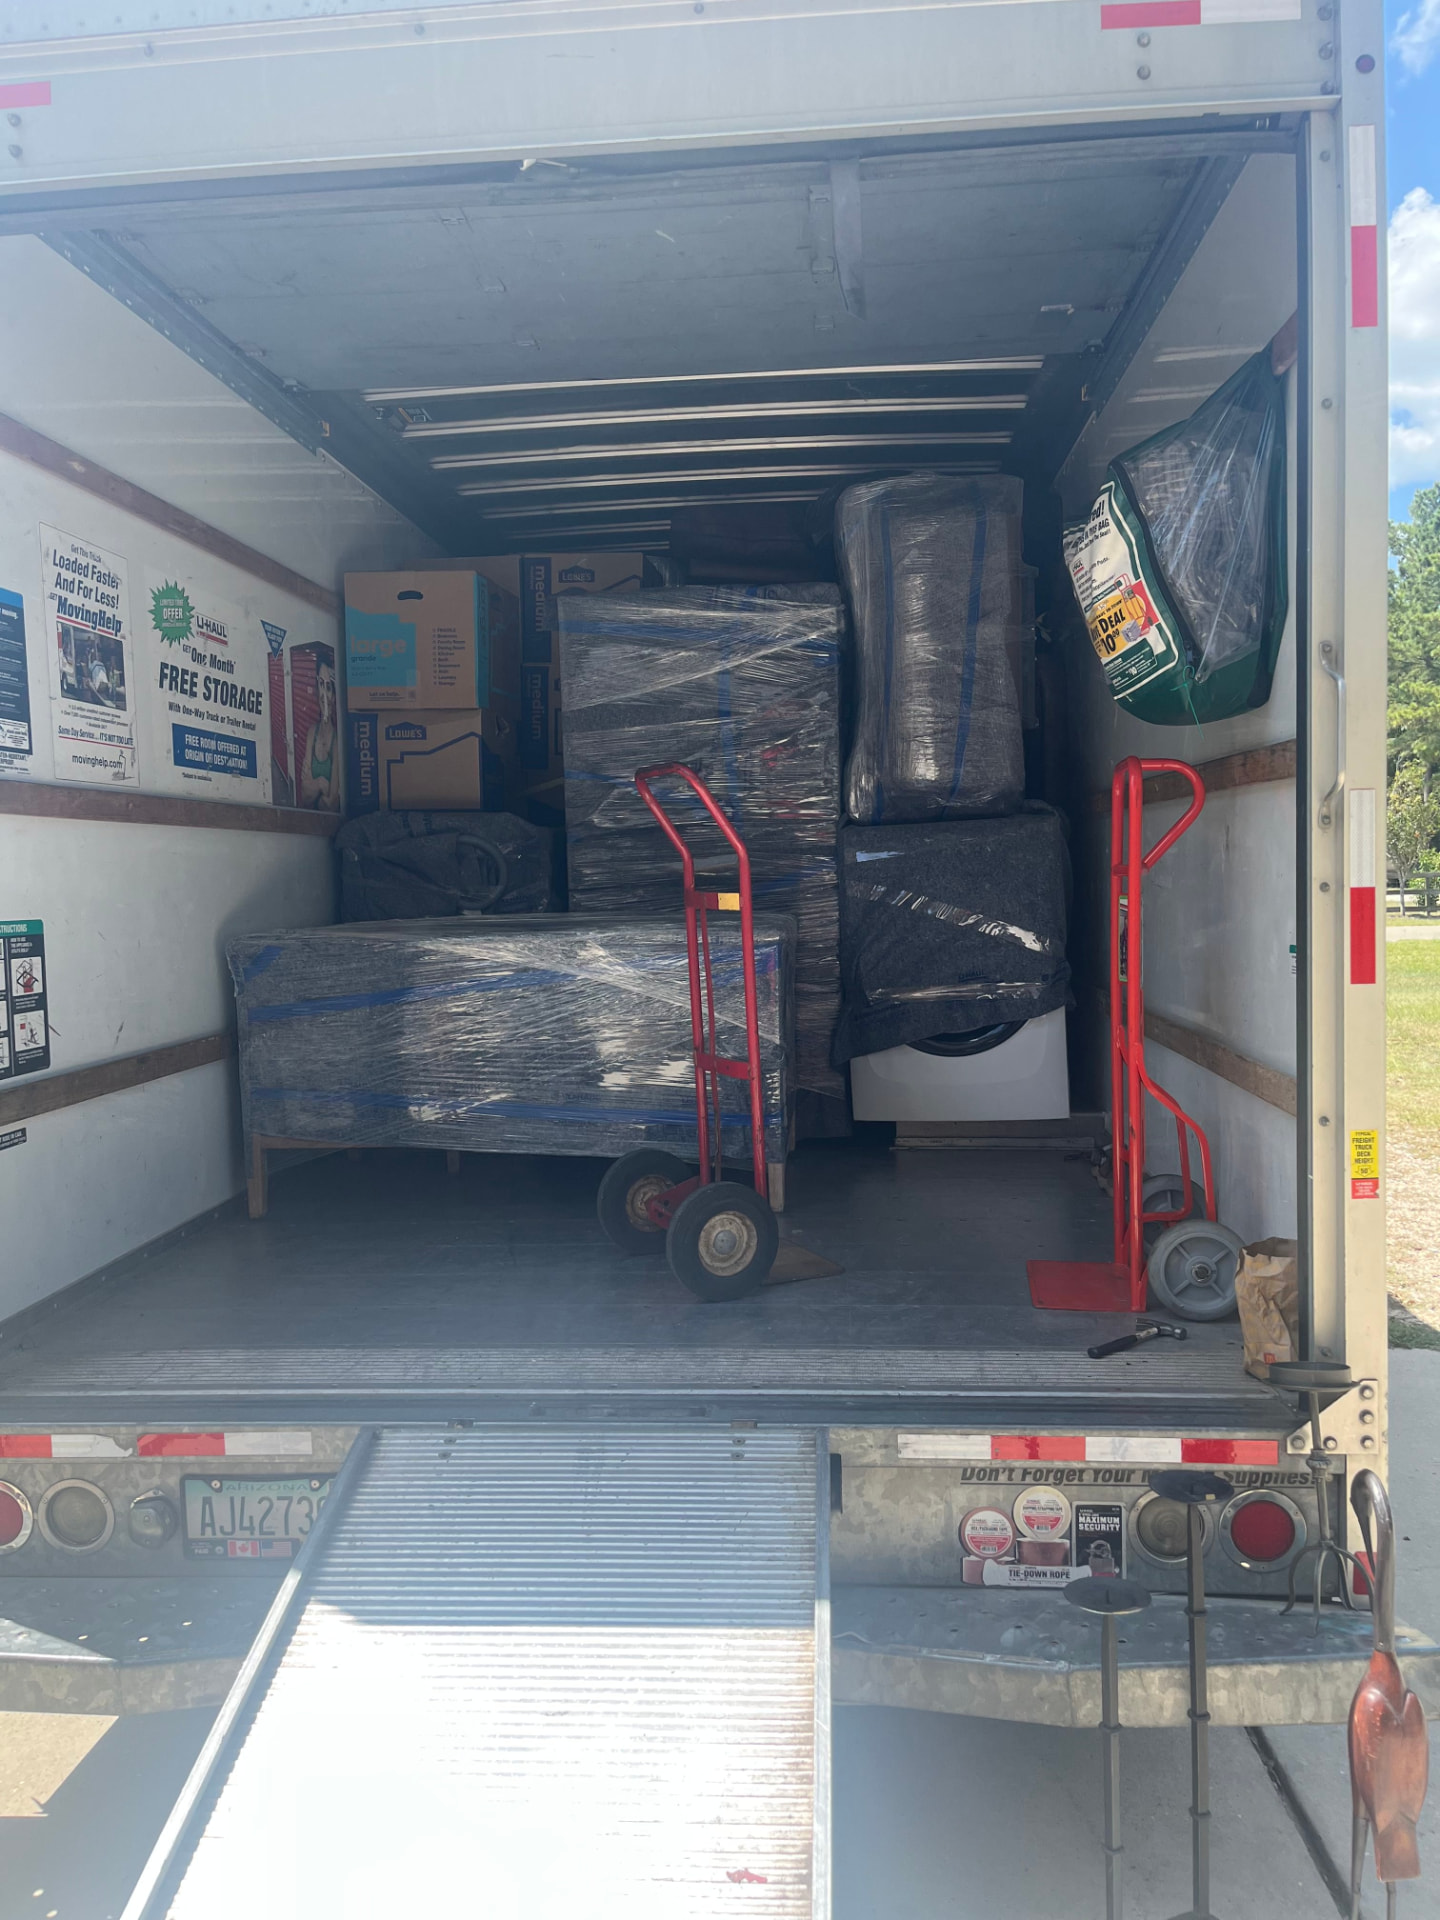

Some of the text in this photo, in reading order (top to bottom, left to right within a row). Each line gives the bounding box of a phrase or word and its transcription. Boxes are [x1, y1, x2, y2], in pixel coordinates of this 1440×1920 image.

[1098, 518, 1110, 530] BAG
[53, 549, 118, 590] Loaded Faster
[55, 572, 119, 610] And For Less!
[536, 566, 545, 632] medium
[57, 595, 122, 638] MovingHelp
[163, 608, 183, 620] OFFER
[1098, 608, 1126, 634] DEAL
[196, 616, 227, 638] U-HAUL
[182, 644, 191, 653] GET
[351, 634, 407, 658] large
[192, 648, 208, 666] One
[351, 655, 376, 664] grande
[159, 662, 262, 716] FREE STORAGE
[168, 701, 180, 714] With
[182, 705, 205, 720] One-Way
[206, 711, 219, 724] Truck
[220, 716, 226, 724] or
[226, 716, 241, 728] Trailer
[532, 674, 544, 739] medium
[58, 725, 70, 736] Same
[124, 737, 134, 746] LATE
[389, 728, 422, 738] LOWE'S
[185, 734, 199, 746] FREE
[218, 741, 239, 756] OFFERED
[240, 746, 247, 756] AT
[185, 749, 204, 762] ORIGIN
[72, 754, 123, 769] movinghelp.com
[360, 722, 375, 795] medium
[225, 1482, 309, 1492] ARIZONA
[960, 1468, 1016, 1482] Don't
[1020, 1468, 1086, 1486] Forget
[1093, 1468, 1136, 1482] Your
[1078, 1516, 1120, 1524] MAXIMUM
[1009, 1570, 1071, 1579] TIE-DOWN ROPE
